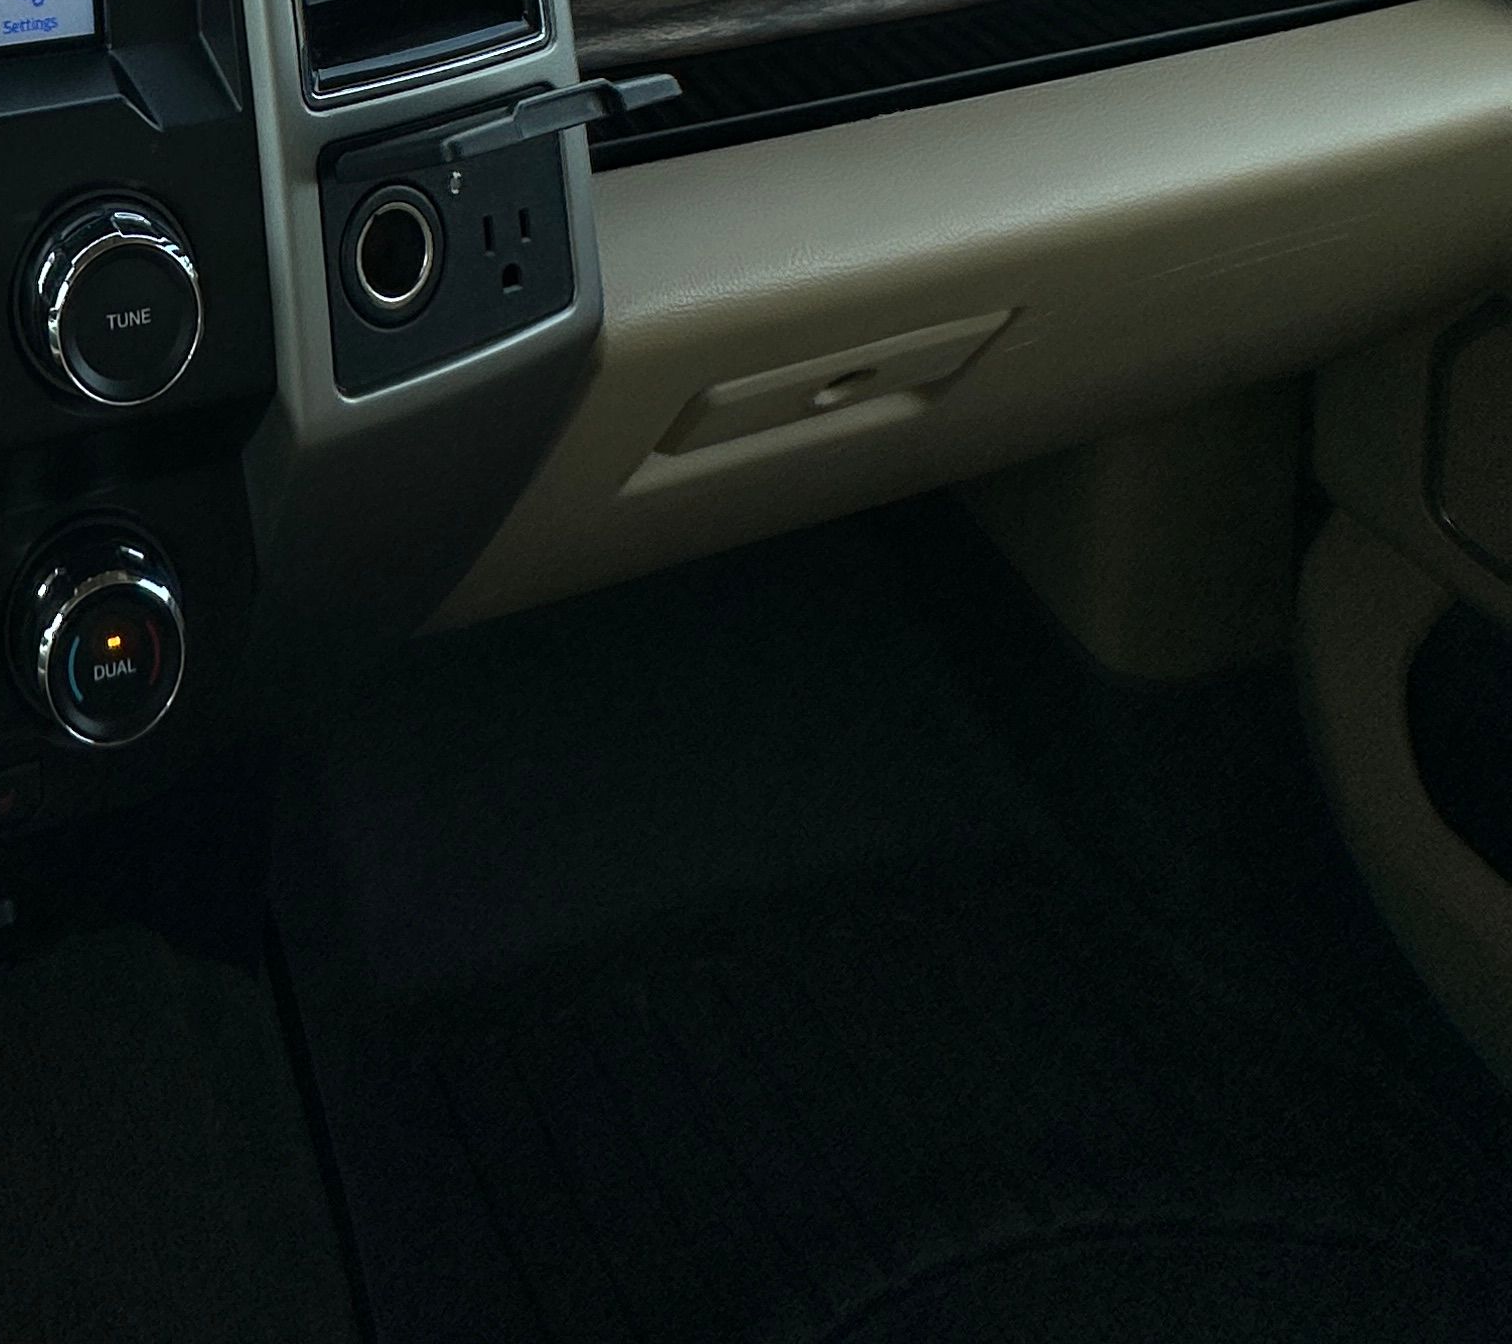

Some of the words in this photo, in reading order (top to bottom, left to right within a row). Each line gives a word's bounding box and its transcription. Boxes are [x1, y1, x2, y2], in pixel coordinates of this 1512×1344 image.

[2, 14, 58, 36] Settings
[106, 307, 152, 330] TUNE
[93, 658, 137, 681] DUAL
